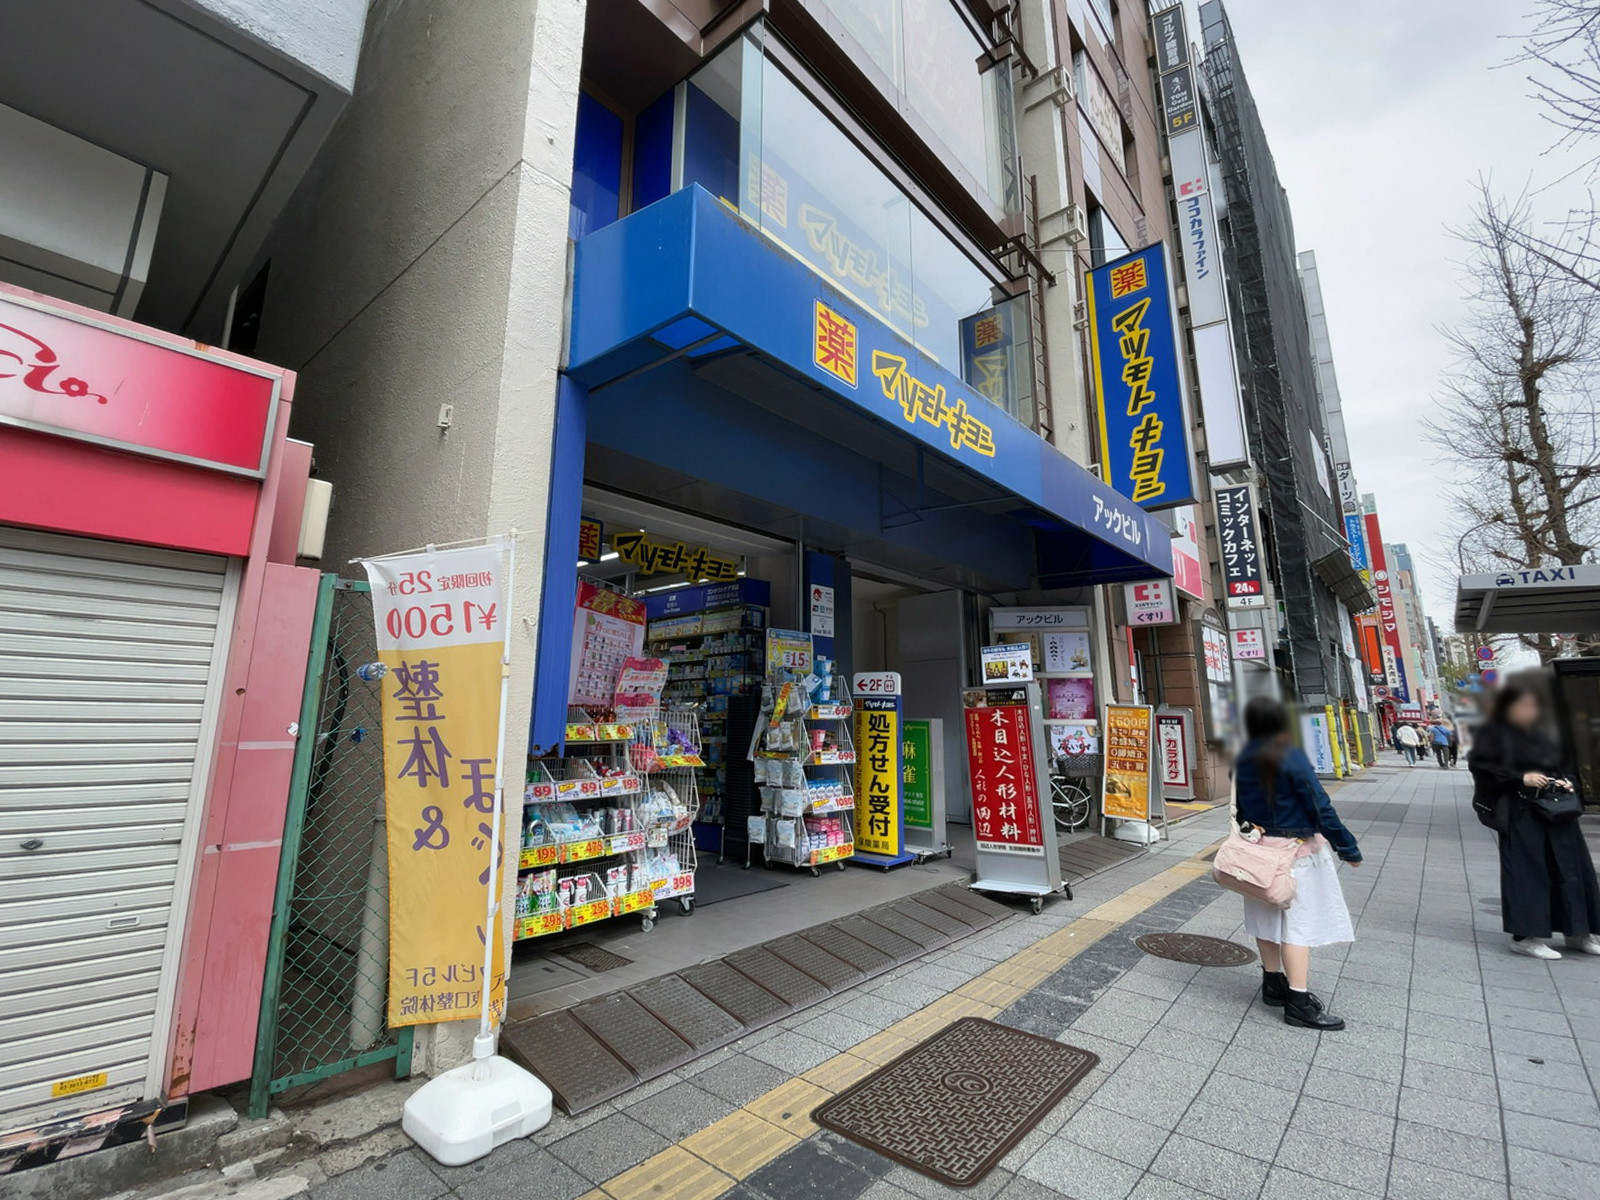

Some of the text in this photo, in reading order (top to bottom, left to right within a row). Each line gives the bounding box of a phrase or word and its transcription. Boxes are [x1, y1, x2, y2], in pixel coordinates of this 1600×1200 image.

[1172, 111, 1194, 128] 5F
[1187, 196, 1210, 281] ココカラファイン
[797, 203, 928, 327] マツモトキヨシ
[1110, 260, 1147, 299] 薬
[815, 308, 857, 384] 薬
[871, 349, 996, 458] マツモトキヨシ
[1112, 297, 1166, 503] マツモトキヨシ
[1339, 470, 1353, 500] ダーツ
[1092, 495, 1142, 545] アックビル
[1217, 492, 1242, 577] コミックカフェ
[1234, 489, 1258, 578] インターネット
[613, 531, 739, 582] マツモトキヨシ
[1518, 567, 1576, 584] TAXI
[1234, 582, 1255, 594] 24h
[1239, 597, 1254, 607] 4F
[1016, 614, 1064, 625] アックビル
[1137, 611, 1164, 622] くすり
[791, 652, 805, 667] 15
[1238, 650, 1259, 658] くすり
[869, 679, 883, 691] 2F
[835, 706, 851, 715] 698
[838, 752, 855, 760] 698
[1166, 738, 1180, 780] カラオケ
[1110, 760, 1144, 771] 五十肩
[868, 712, 891, 838] 処方せん受付
[989, 708, 1023, 841] 木目込人形材料
[580, 782, 597, 794] 89
[622, 778, 639, 789] 198
[533, 785, 551, 798] 89
[835, 797, 854, 807] 1080
[858, 837, 890, 850] 保険薬局
[536, 846, 557, 860] 198
[673, 874, 693, 890] 398
[637, 890, 654, 903] 258
[591, 901, 609, 915] 258
[542, 914, 563, 929] 298
